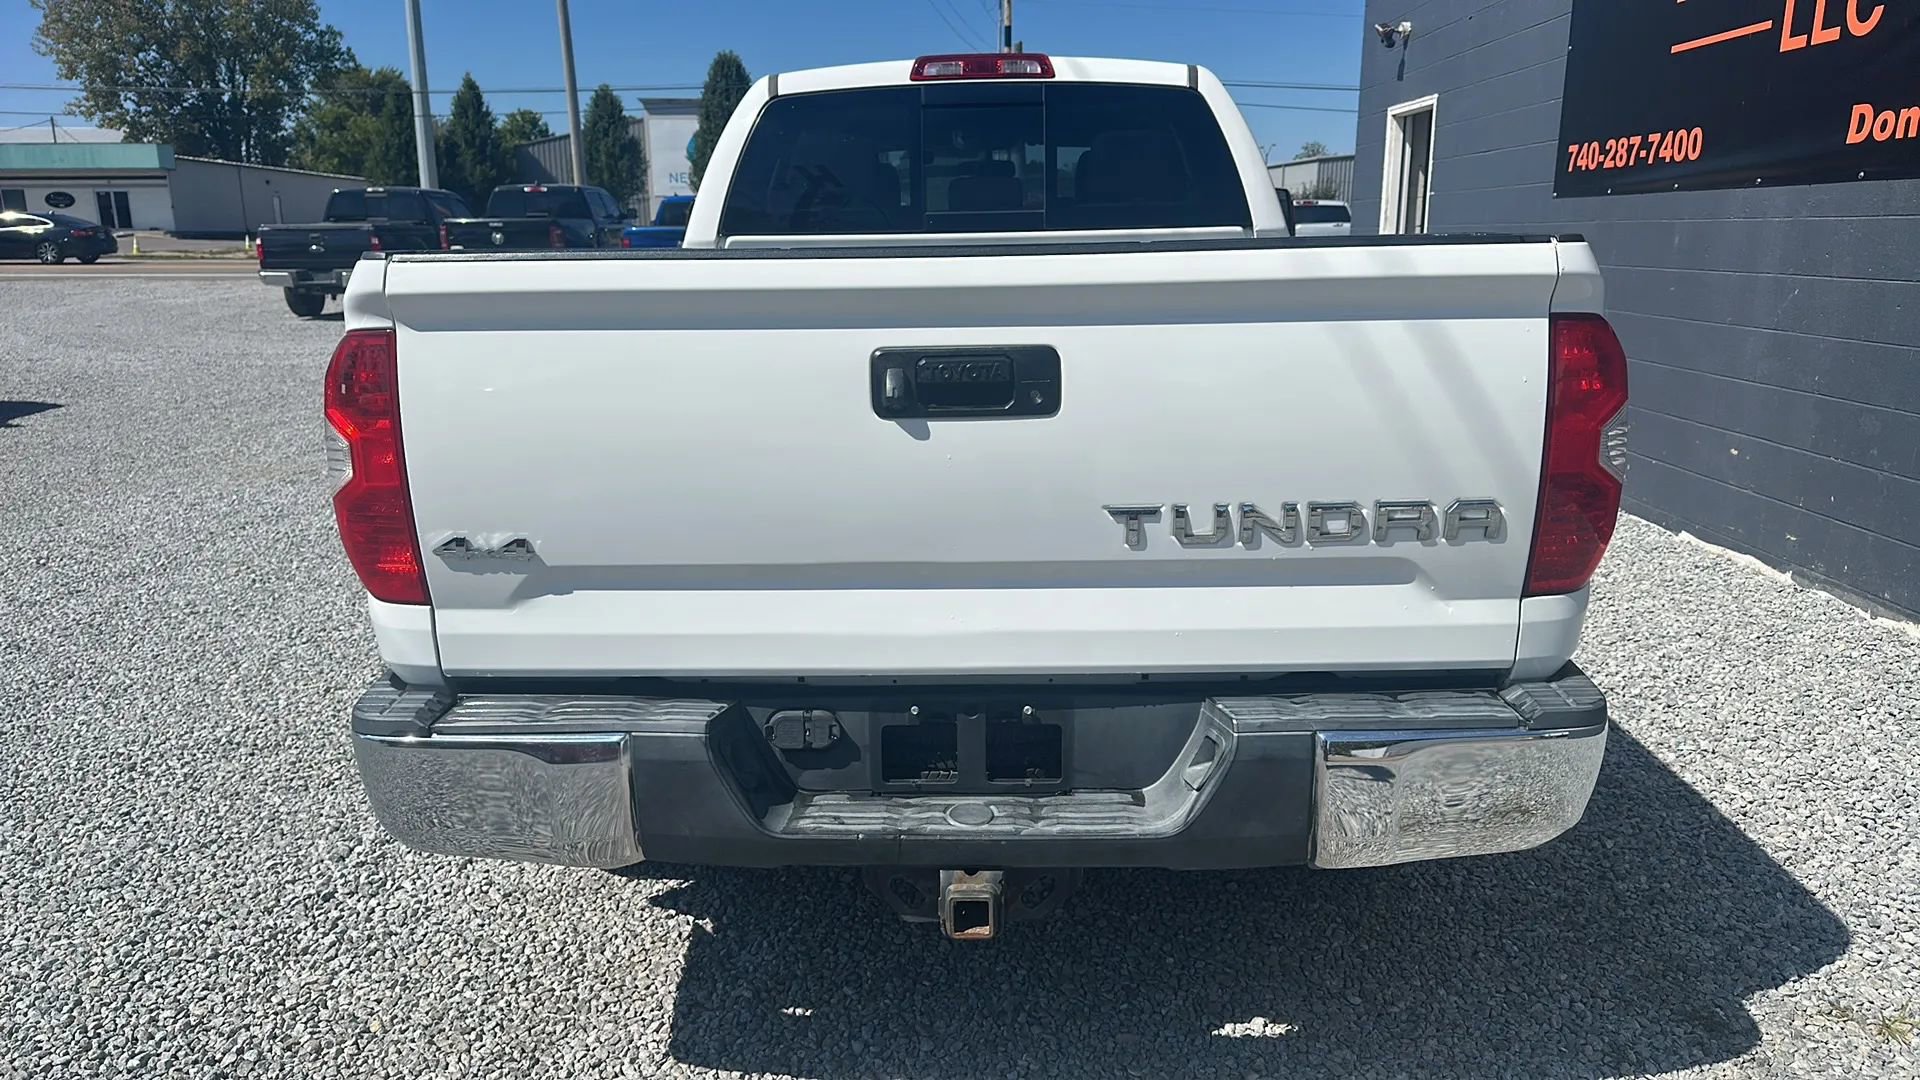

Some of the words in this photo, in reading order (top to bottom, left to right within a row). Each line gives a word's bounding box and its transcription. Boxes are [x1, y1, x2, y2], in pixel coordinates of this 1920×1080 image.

[1779, 0, 1885, 52] LLC
[1567, 127, 1703, 172] 740-287-7400
[669, 172, 690, 184] NE
[924, 362, 1008, 382] TOYOTA
[1102, 498, 1505, 548] TUNDRA
